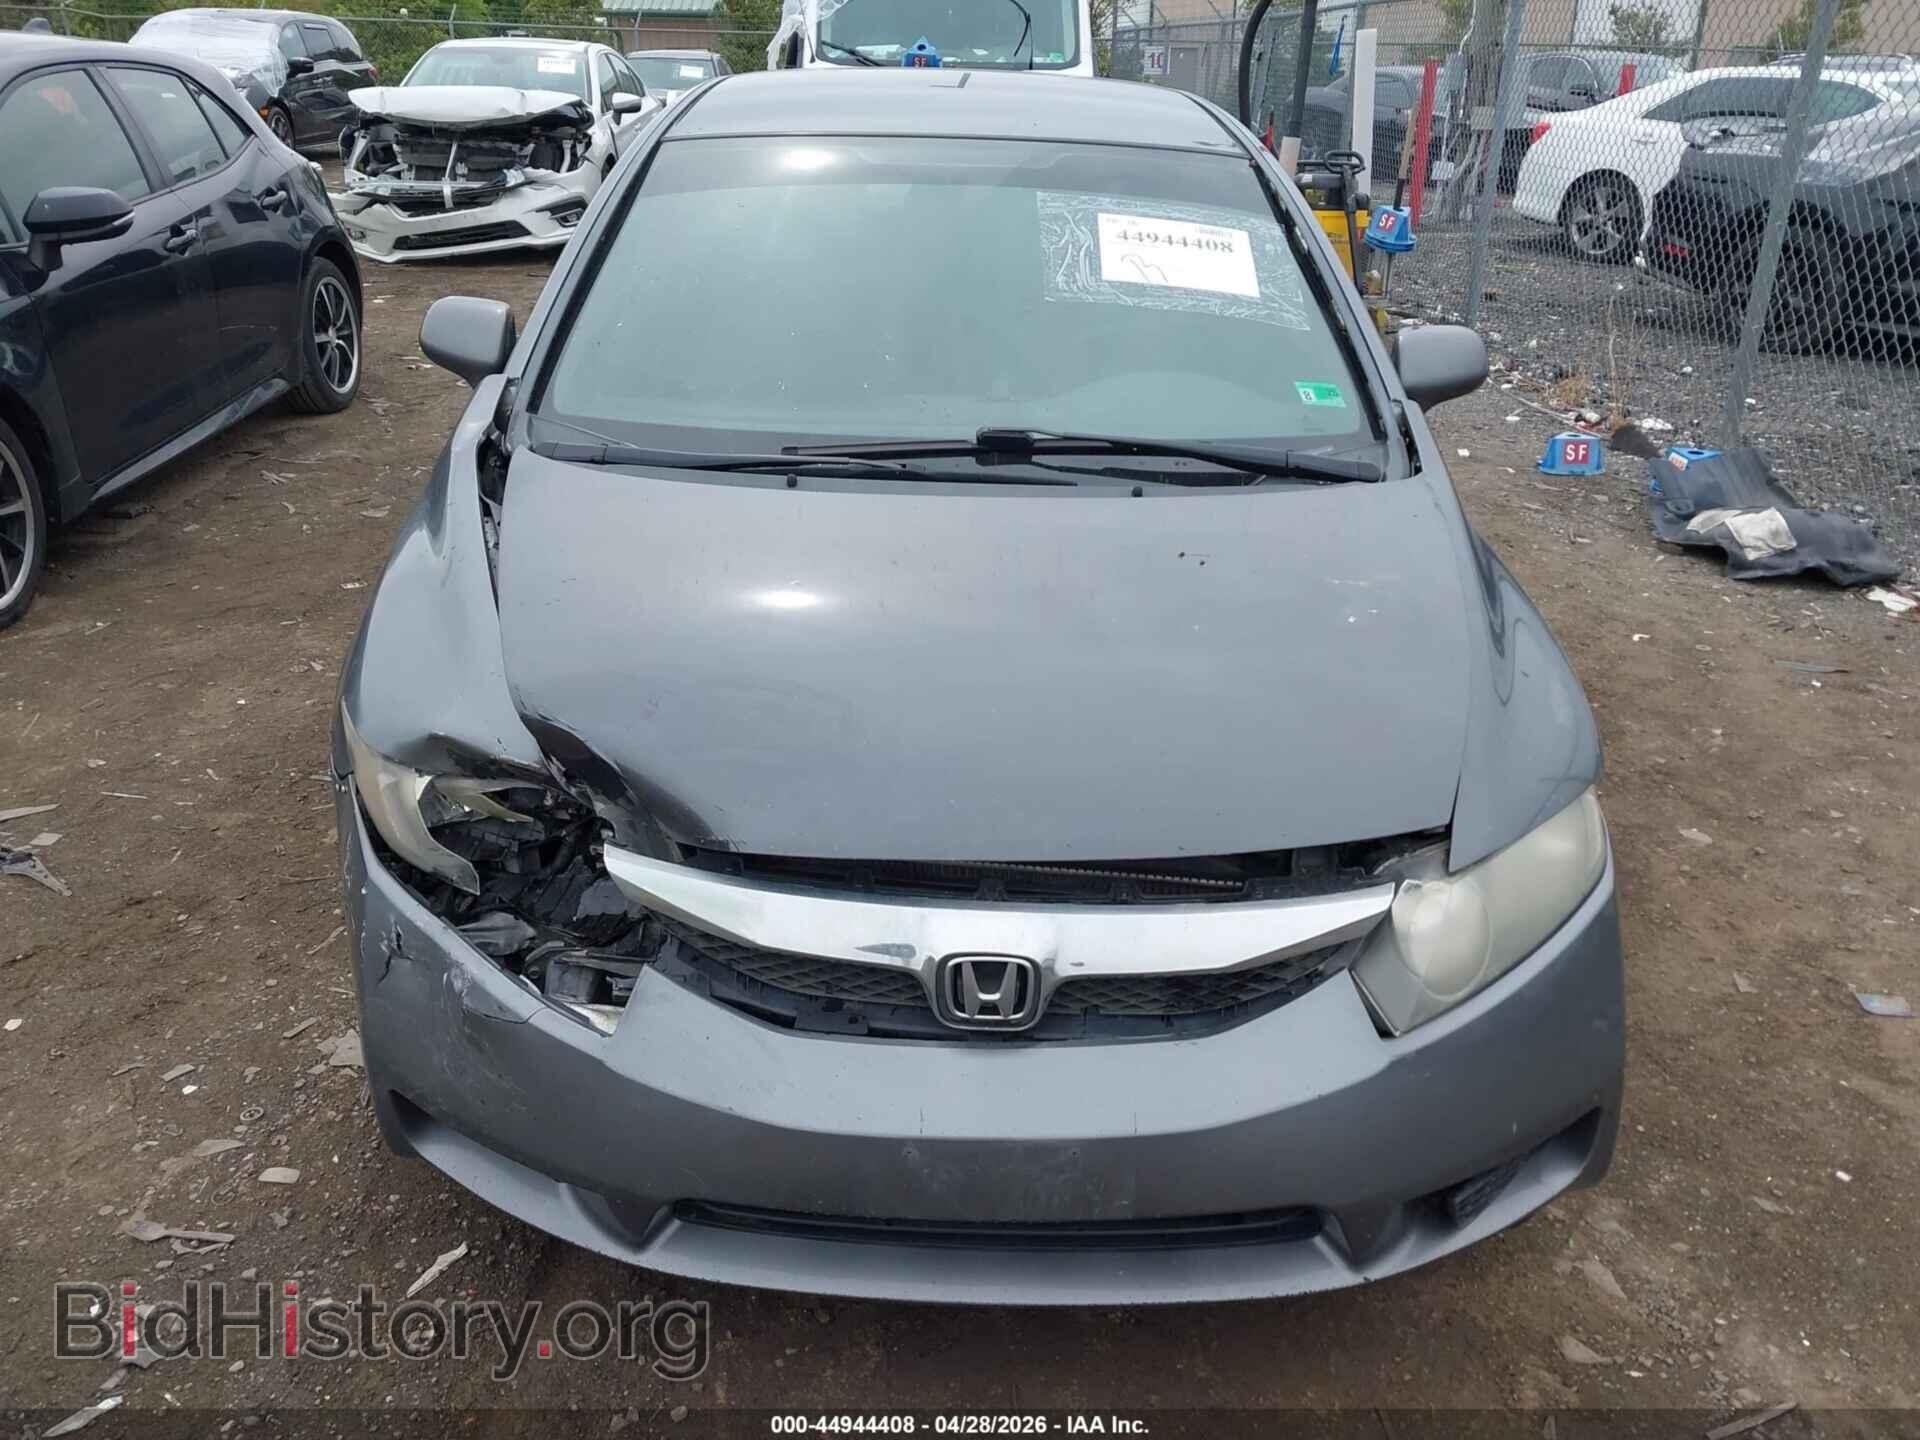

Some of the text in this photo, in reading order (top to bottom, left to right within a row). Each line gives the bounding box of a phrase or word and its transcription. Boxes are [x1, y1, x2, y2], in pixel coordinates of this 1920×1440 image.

[912, 56, 927, 69] SF
[1379, 214, 1395, 229] SF
[1116, 229, 1234, 253] 44944408
[1566, 444, 1588, 462] SF
